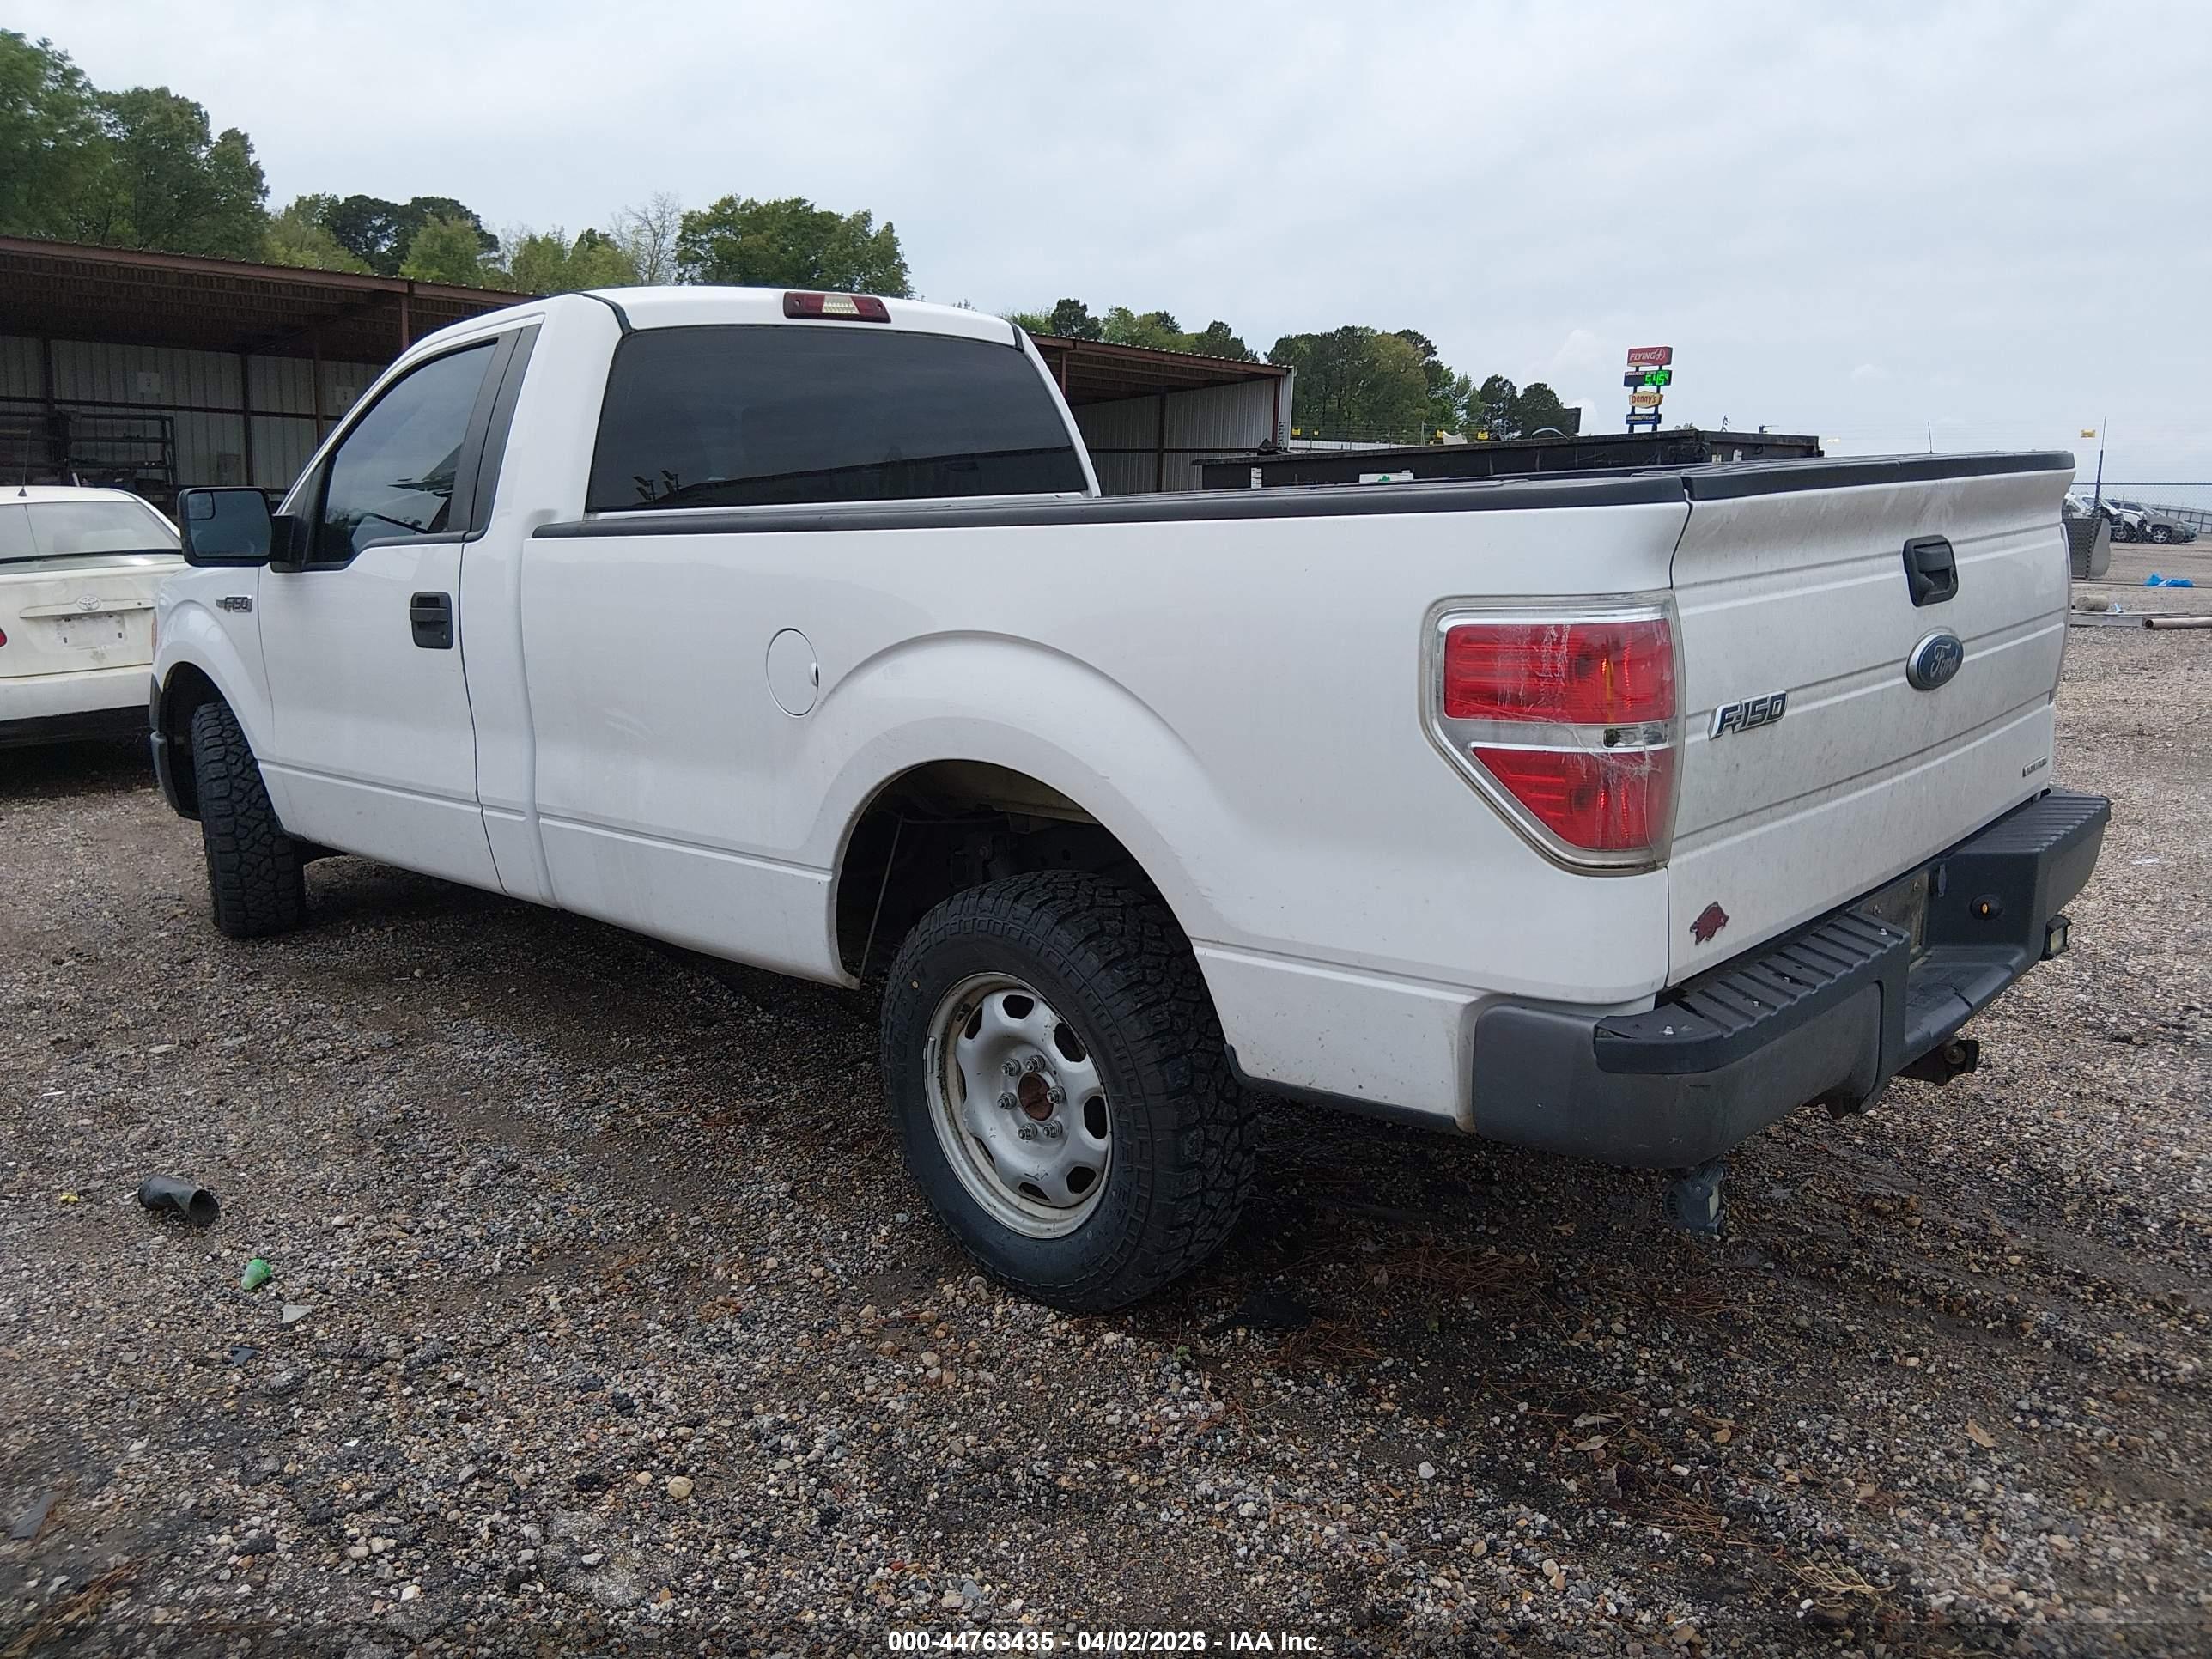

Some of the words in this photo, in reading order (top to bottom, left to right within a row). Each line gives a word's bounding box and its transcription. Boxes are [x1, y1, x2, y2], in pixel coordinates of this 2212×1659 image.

[1630, 352, 1656, 361] FLYING
[1632, 394, 1656, 404] Denny's
[1929, 643, 1958, 678] Ford
[1708, 690, 1789, 741] F-150
